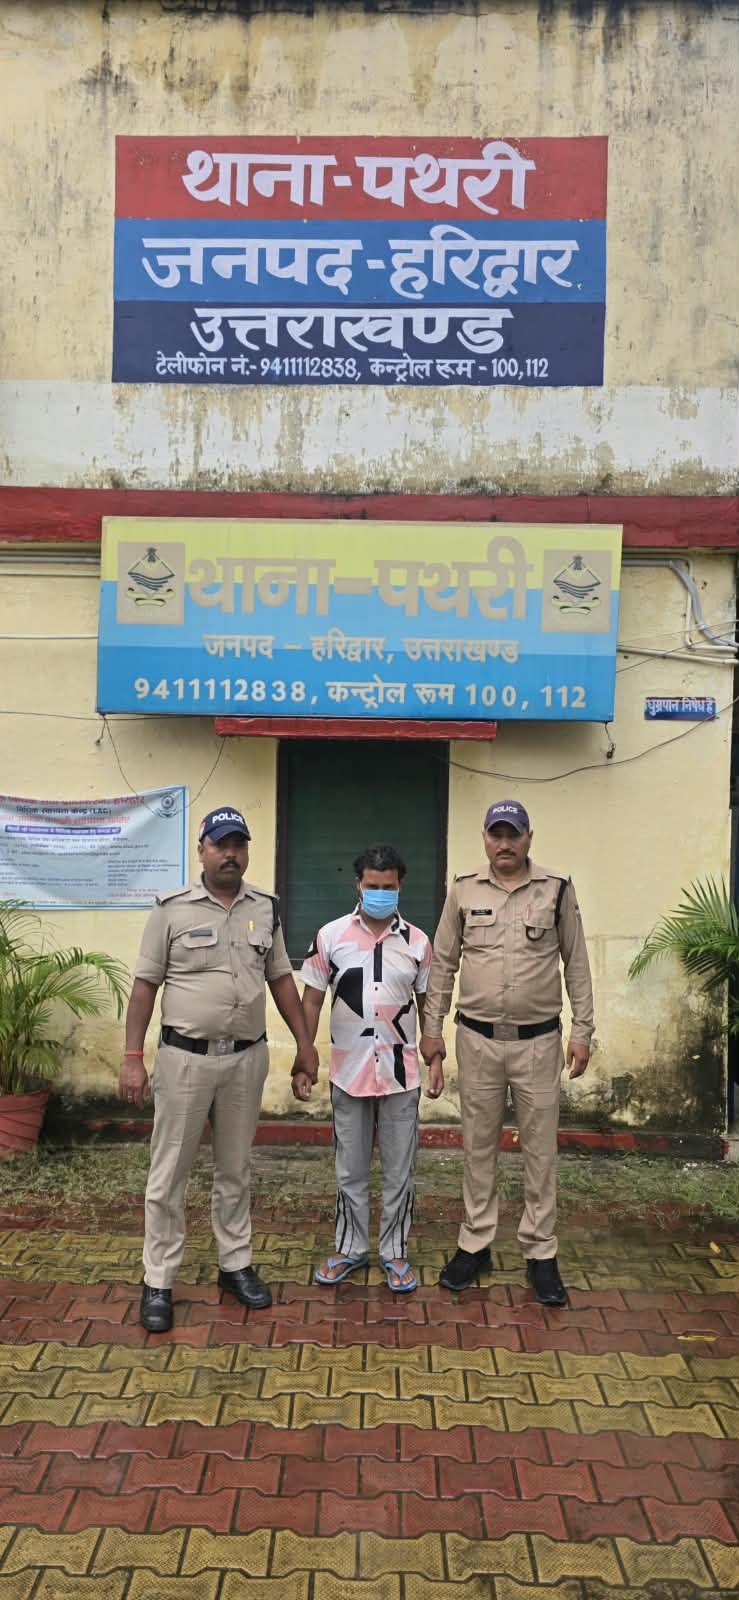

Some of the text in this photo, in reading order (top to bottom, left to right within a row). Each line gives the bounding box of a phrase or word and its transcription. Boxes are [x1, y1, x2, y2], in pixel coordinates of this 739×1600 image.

[182, 141, 536, 216] थाना-पथरी
[190, 307, 514, 354] उत्तराखण्ड
[155, 351, 227, 376] टेलीफोन
[261, 357, 361, 381] 9411112838,
[368, 353, 433, 382] कन्ट्रोल
[436, 359, 476, 379] रूम
[202, 634, 275, 659] जनपद
[309, 628, 394, 663] हरिद्वार,
[401, 637, 520, 663] उत्तराखण्ड
[325, 674, 407, 709] कन्ट्रोल
[413, 682, 455, 705] रूम
[540, 685, 586, 708] 112
[212, 812, 245, 824] POLICE
[492, 805, 518, 814] POLICE
